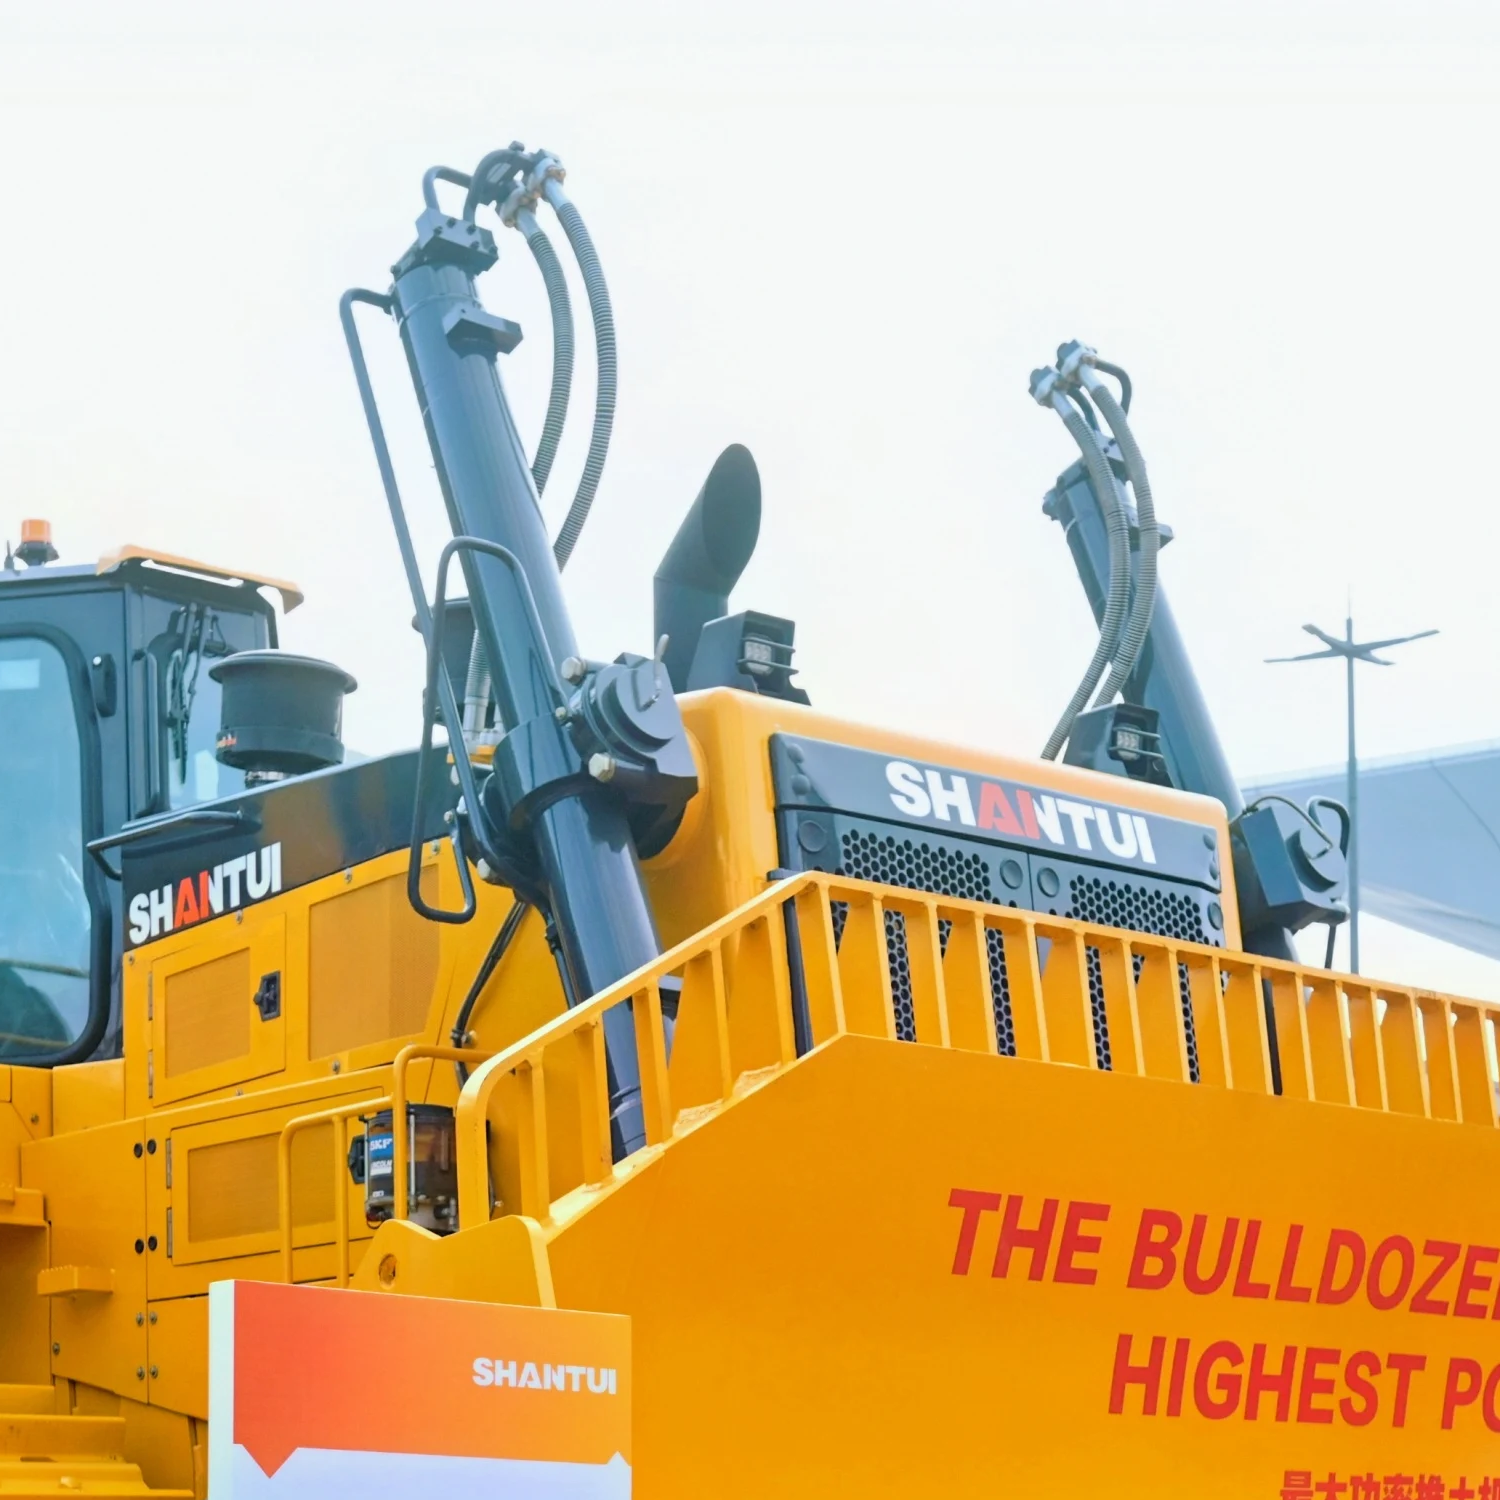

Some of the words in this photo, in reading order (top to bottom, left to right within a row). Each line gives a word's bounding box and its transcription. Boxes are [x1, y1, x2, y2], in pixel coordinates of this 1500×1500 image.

[884, 760, 1157, 864] SHANTUI
[129, 841, 282, 946] SHANTUI
[947, 1187, 1112, 1286] THE
[471, 1357, 617, 1395] SHANTUI
[1108, 1333, 1428, 1428] HIGHEST
